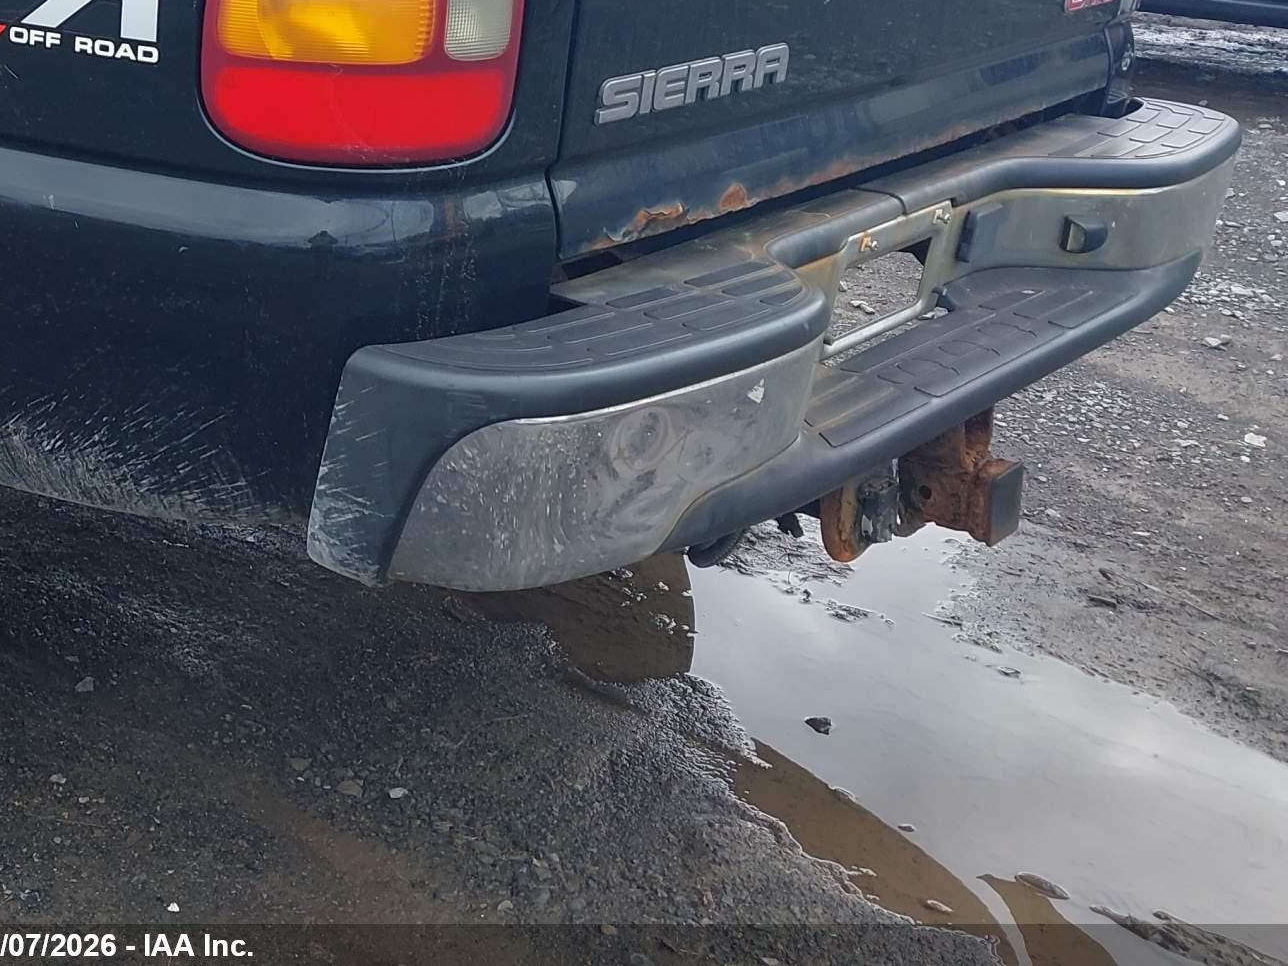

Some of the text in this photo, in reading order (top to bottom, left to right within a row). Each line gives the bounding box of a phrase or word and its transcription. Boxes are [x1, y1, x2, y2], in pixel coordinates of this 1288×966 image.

[9, 26, 159, 64] OFF ROAD
[594, 42, 790, 126] SIERRA
